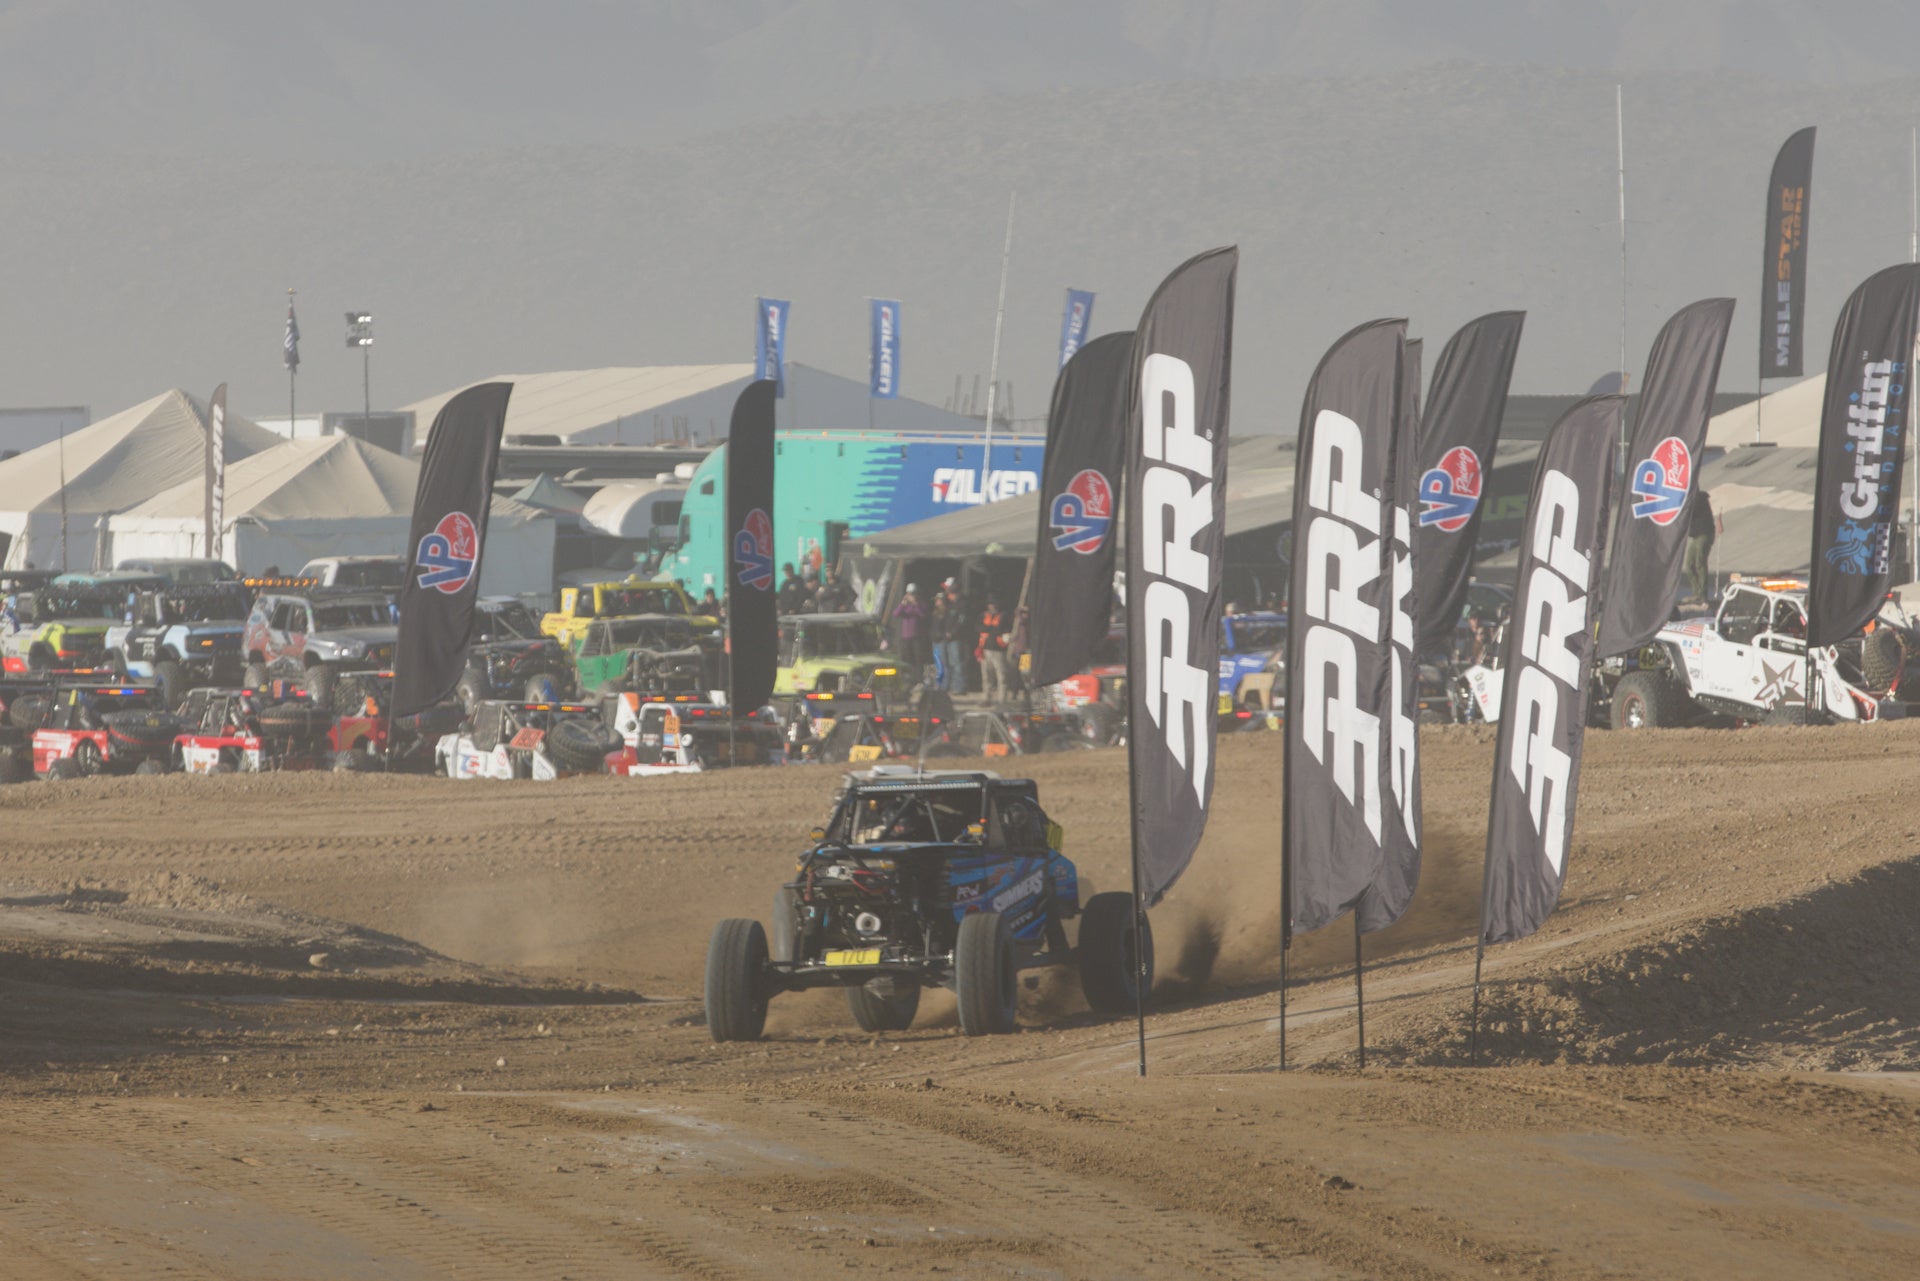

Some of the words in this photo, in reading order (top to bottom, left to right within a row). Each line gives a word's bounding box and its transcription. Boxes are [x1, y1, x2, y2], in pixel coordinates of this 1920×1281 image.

[1776, 187, 1795, 366] MILESTAR
[879, 306, 893, 394] FALKEN
[1668, 440, 1684, 485] Racing
[1840, 359, 1891, 519] Griffin
[933, 468, 1038, 504] FALKEN
[1087, 474, 1106, 514] Racing
[1418, 470, 1478, 530] VP
[1456, 451, 1474, 492] Racing
[1632, 459, 1686, 519] VP
[1050, 492, 1112, 553] VP
[417, 532, 475, 590] VP
[735, 531, 774, 586] VP
[1142, 352, 1213, 810] PRP
[1303, 409, 1381, 847] PRP
[1511, 469, 1589, 876] PRP
